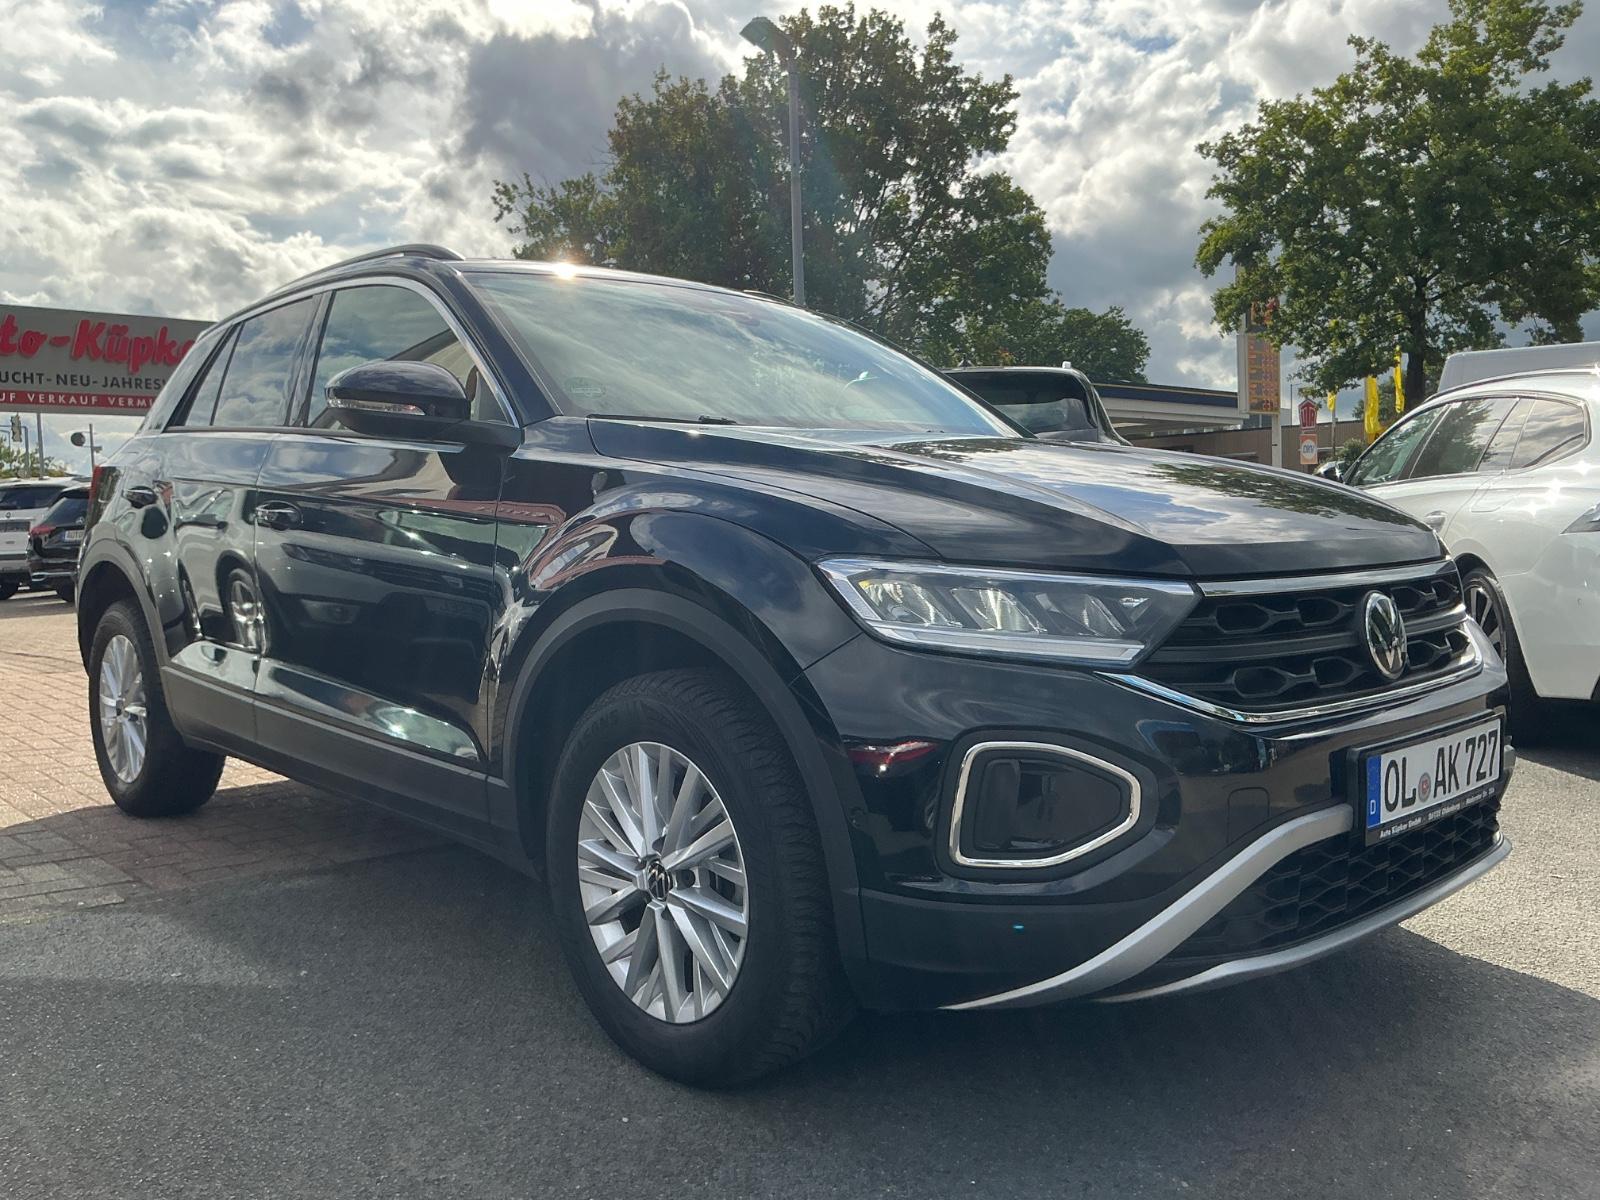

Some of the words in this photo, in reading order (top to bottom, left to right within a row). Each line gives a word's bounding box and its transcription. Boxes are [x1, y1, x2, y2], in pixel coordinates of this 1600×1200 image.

[27, 393, 98, 405] VERKAUF
[1384, 757, 1416, 812] OL
[1434, 742, 1461, 798] AK
[1466, 729, 1498, 786] 727
